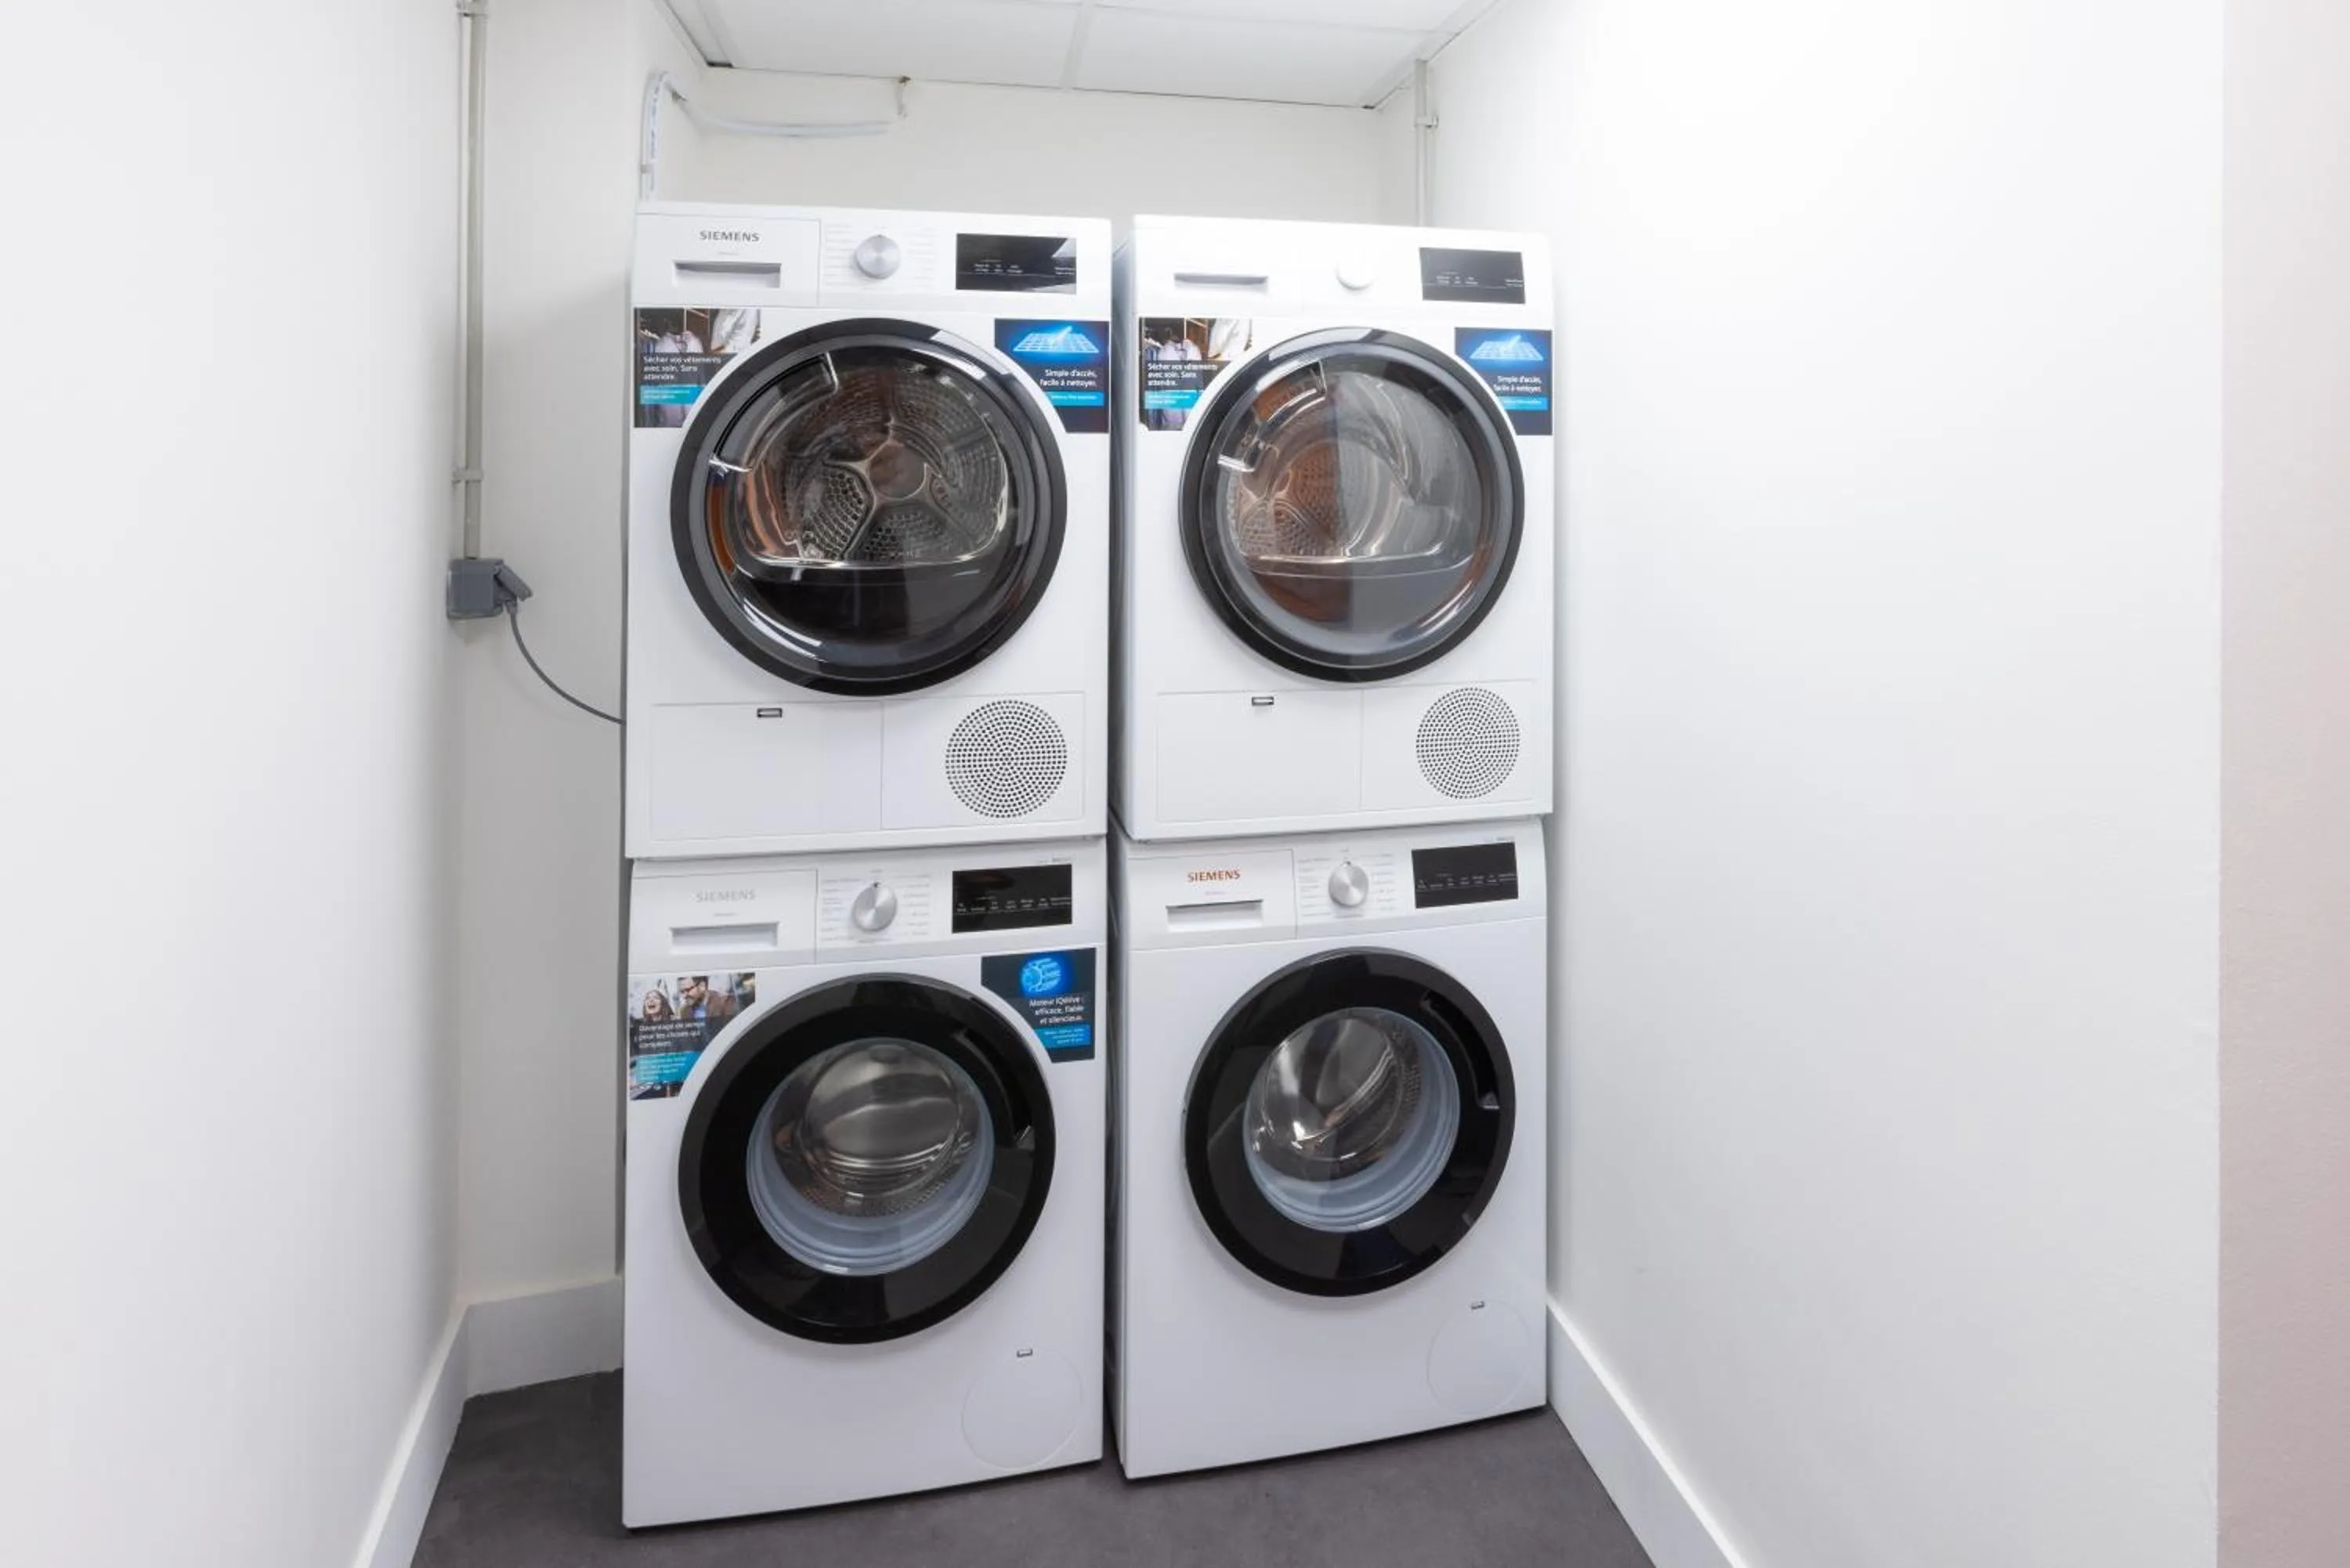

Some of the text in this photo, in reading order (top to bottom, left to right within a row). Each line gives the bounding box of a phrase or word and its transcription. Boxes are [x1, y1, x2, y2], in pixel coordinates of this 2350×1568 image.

[700, 231, 760, 242] SIEMENS
[1187, 869, 1241, 883] SIEMENS
[696, 890, 756, 903] SIEMENS
